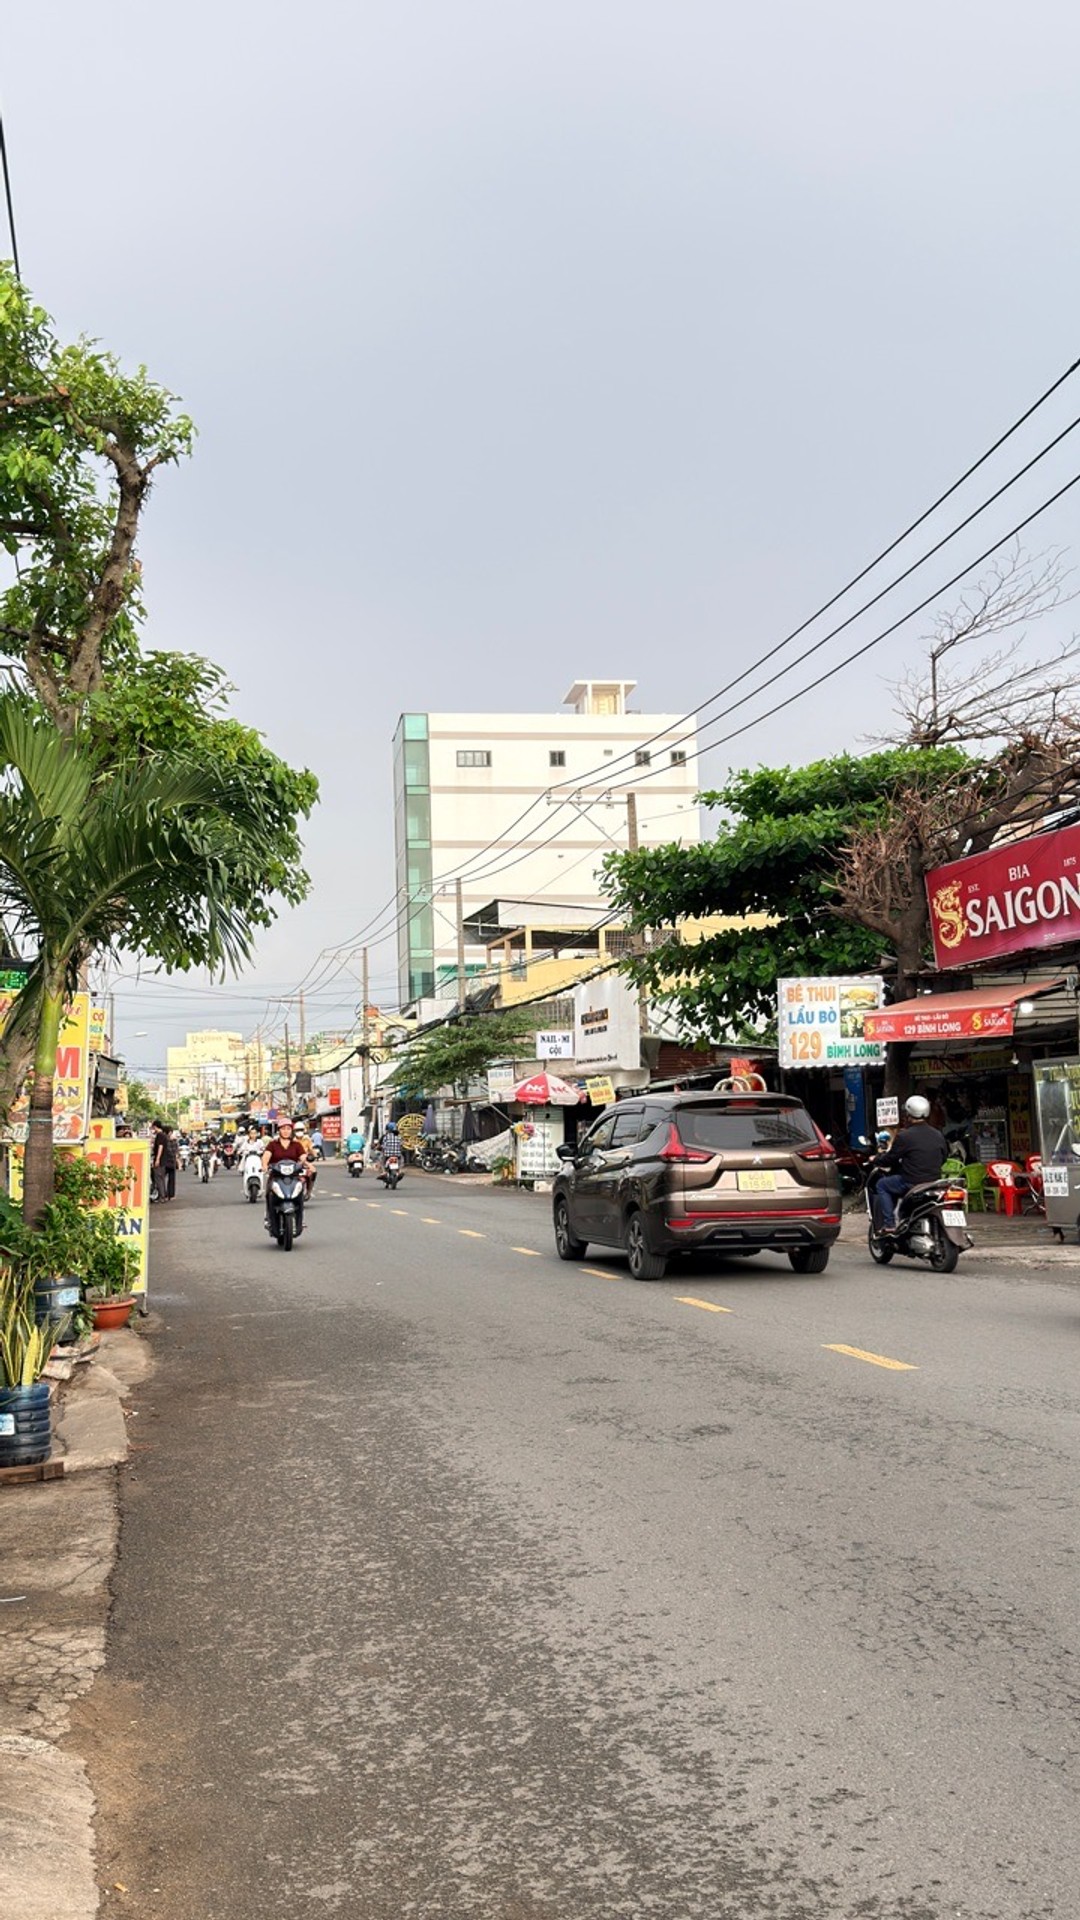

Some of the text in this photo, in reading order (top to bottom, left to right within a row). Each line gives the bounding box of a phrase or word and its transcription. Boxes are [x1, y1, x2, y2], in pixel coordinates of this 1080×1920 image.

[1008, 864, 1030, 881] BIA
[966, 873, 1080, 937] SAIGON
[807, 986, 836, 1002] THUI
[818, 1007, 837, 1024] BÒ
[904, 1025, 916, 1034] 129
[917, 1021, 937, 1034] BÌNH
[938, 1022, 961, 1033] LONG
[540, 1035, 557, 1043] NAIL
[789, 1031, 822, 1061] 129
[827, 1042, 881, 1059] BÌNH LONG
